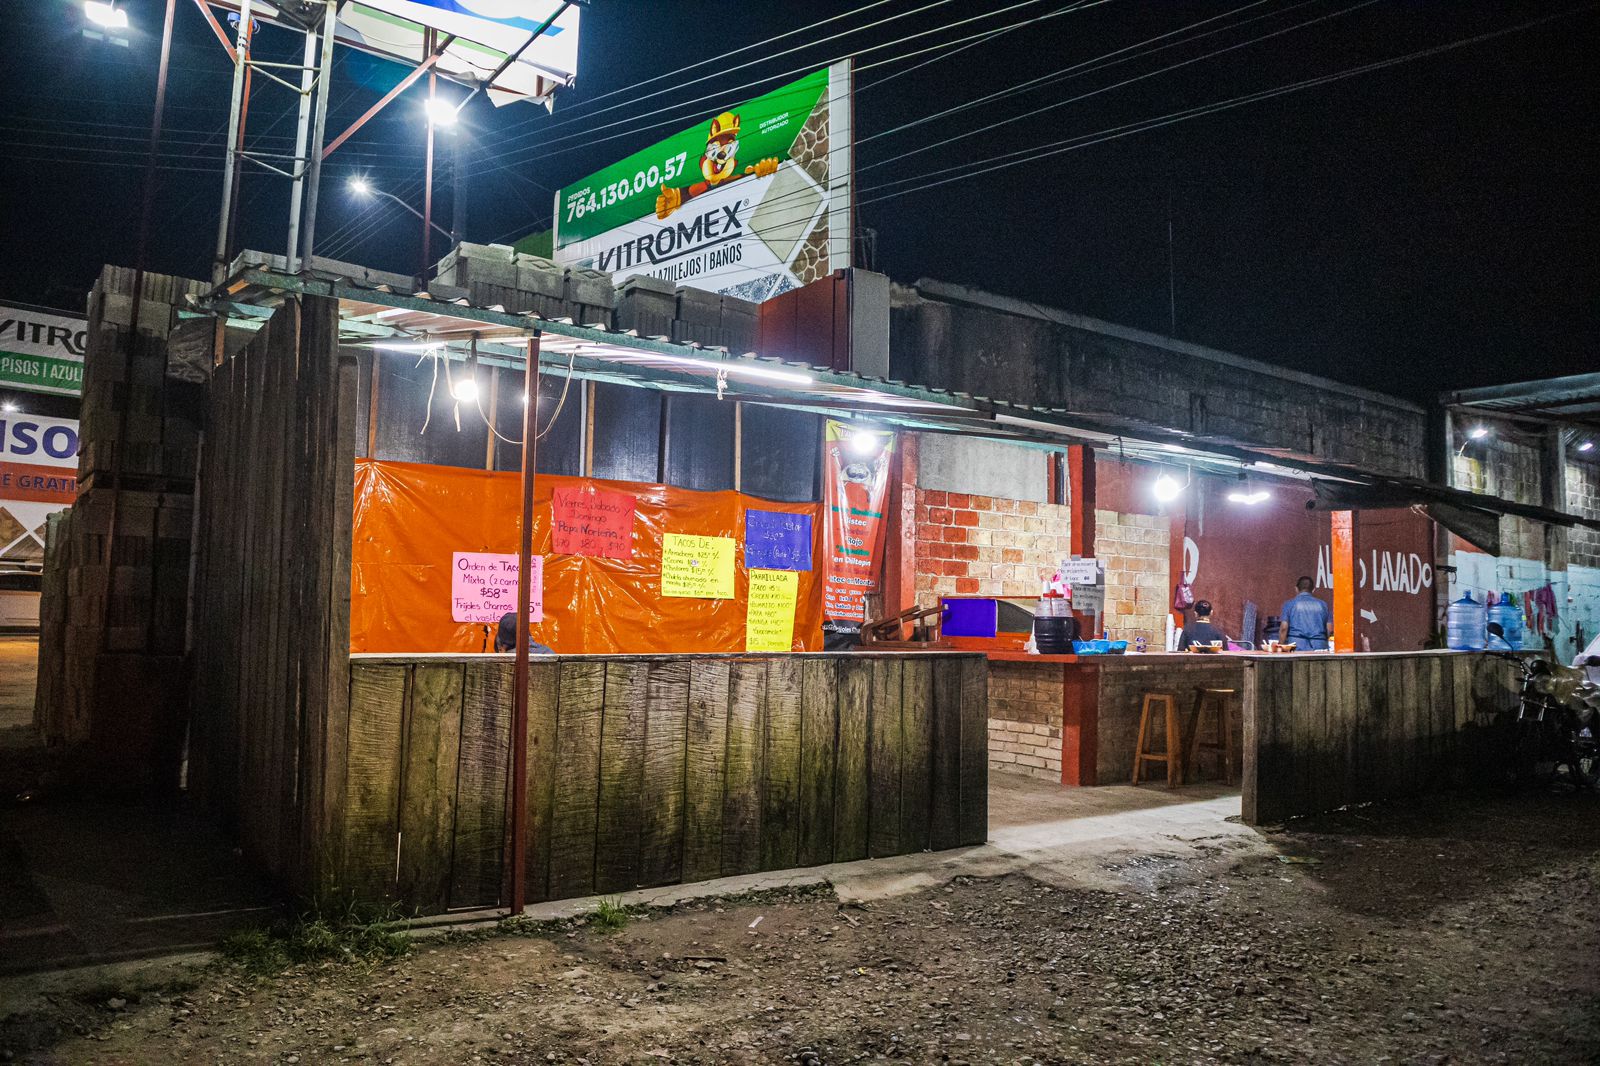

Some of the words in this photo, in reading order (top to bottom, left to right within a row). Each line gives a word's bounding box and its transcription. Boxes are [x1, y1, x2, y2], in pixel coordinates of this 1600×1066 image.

[760, 112, 789, 129] DISTRIBUIDOR
[761, 119, 789, 135] AUTORIZADO
[566, 152, 687, 223] 764.130.00.57
[568, 187, 591, 202] PEDIDOS
[598, 200, 742, 271] VITROMEX
[709, 243, 742, 270] BAÑOS
[1, 357, 40, 376] PISOS
[672, 536, 696, 548] TACOS
[458, 558, 486, 571] Orden
[488, 562, 497, 571] de
[463, 573, 486, 585] Mixta
[483, 600, 514, 611] Charros
[464, 613, 472, 621] el
